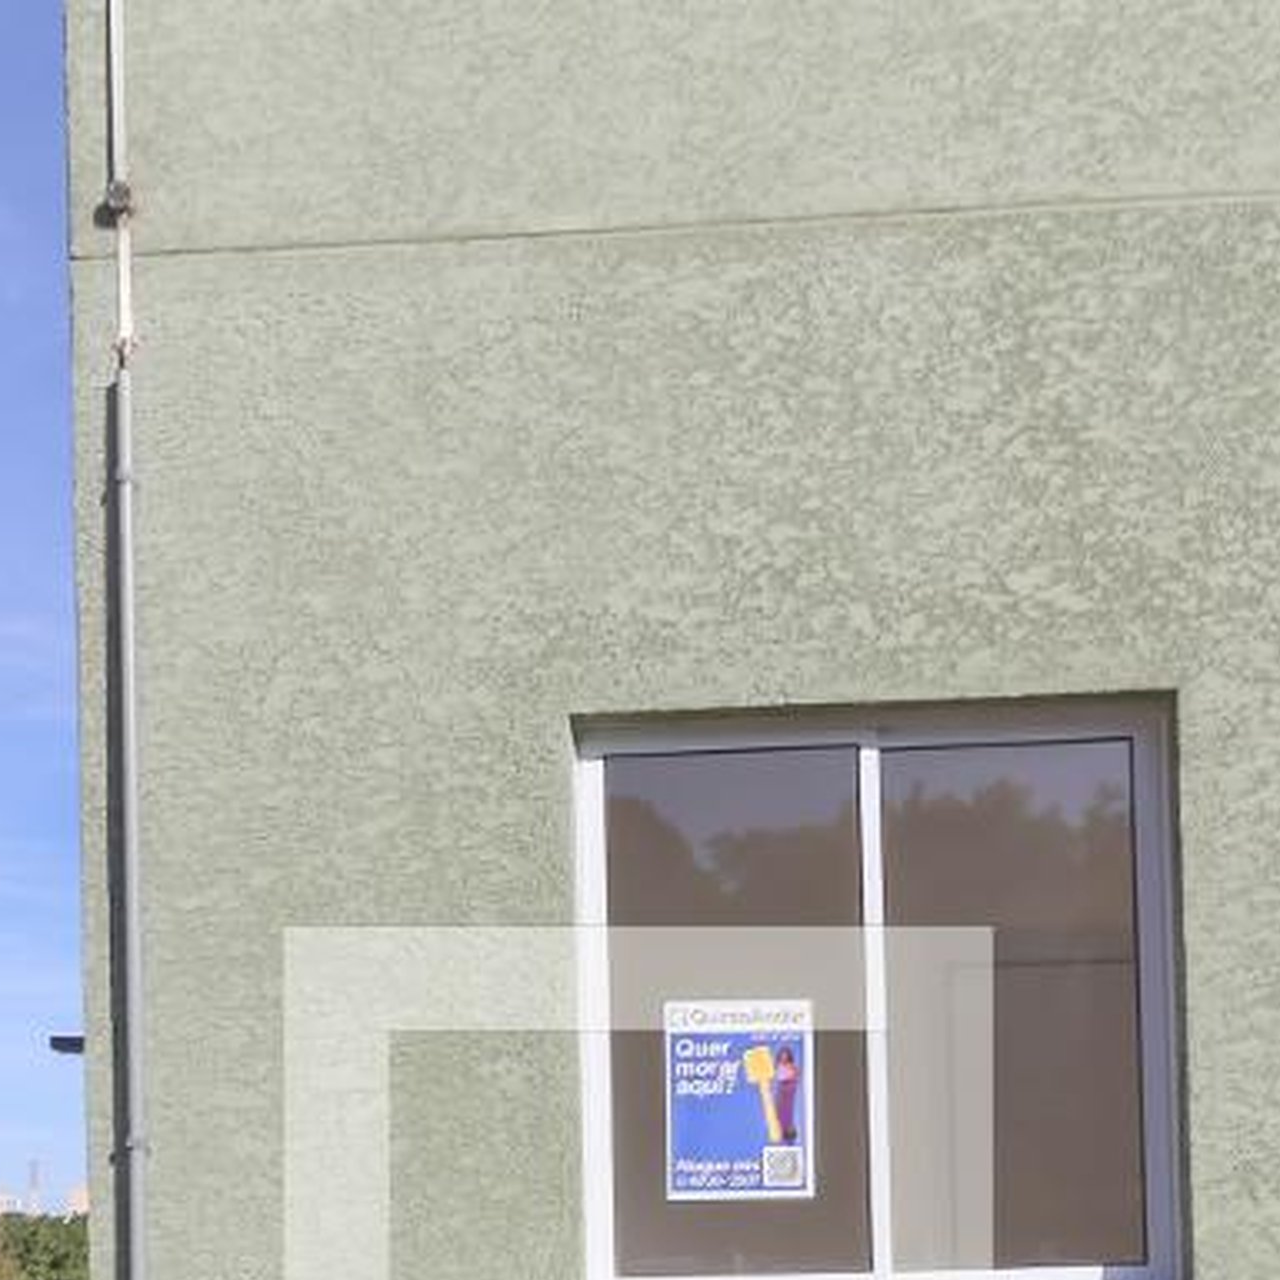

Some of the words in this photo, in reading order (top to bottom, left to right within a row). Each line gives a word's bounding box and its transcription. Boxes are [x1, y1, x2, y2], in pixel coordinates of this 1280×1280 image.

[676, 1039, 729, 1058] Quer
[675, 1060, 739, 1078] morar
[675, 1080, 735, 1099] aqui?
